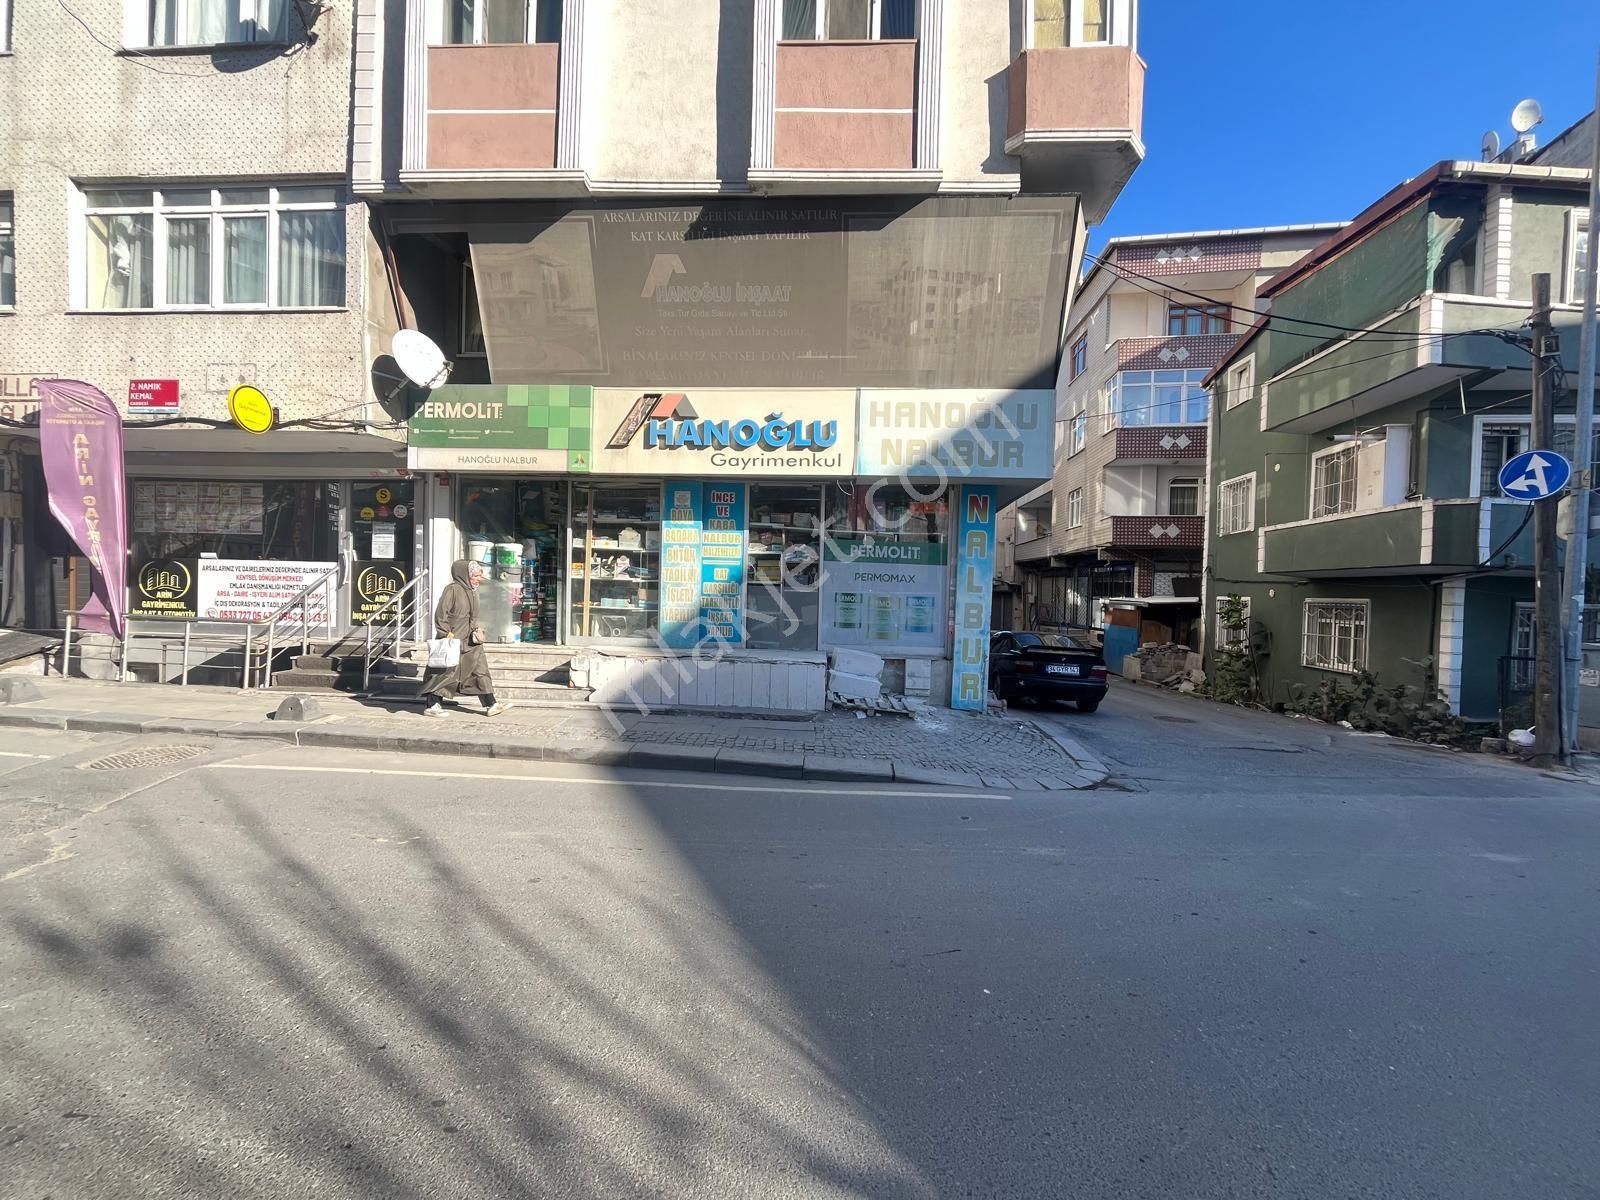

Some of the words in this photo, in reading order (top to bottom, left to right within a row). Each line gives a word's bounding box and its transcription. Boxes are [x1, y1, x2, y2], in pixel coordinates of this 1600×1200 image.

[602, 211, 681, 223] ARSALARINIZ
[745, 208, 788, 221] ALINIR
[791, 207, 838, 220] SATILIR
[630, 231, 655, 242] KAT
[763, 230, 811, 241] YAPILIR
[656, 281, 732, 303] HANOĞLU
[735, 281, 792, 306] İNŞAAT
[130, 392, 154, 400] KEMAL
[869, 396, 1039, 430] HANOĞLU
[649, 411, 838, 449] HANOĞLU
[880, 438, 1025, 468] NALBUR
[458, 454, 501, 464] HANOĞLU
[503, 456, 538, 465] NALBUR
[710, 453, 842, 470] Gayrimenkul
[711, 490, 736, 503] İNCE
[716, 506, 730, 517] VE
[709, 519, 737, 530] KABA
[703, 533, 741, 543] NALBUR
[854, 572, 916, 584] PERMOMAX
[156, 590, 173, 599] ARİN
[959, 494, 990, 701] NALBUR
[141, 599, 187, 609] GAYRİMENKUL
